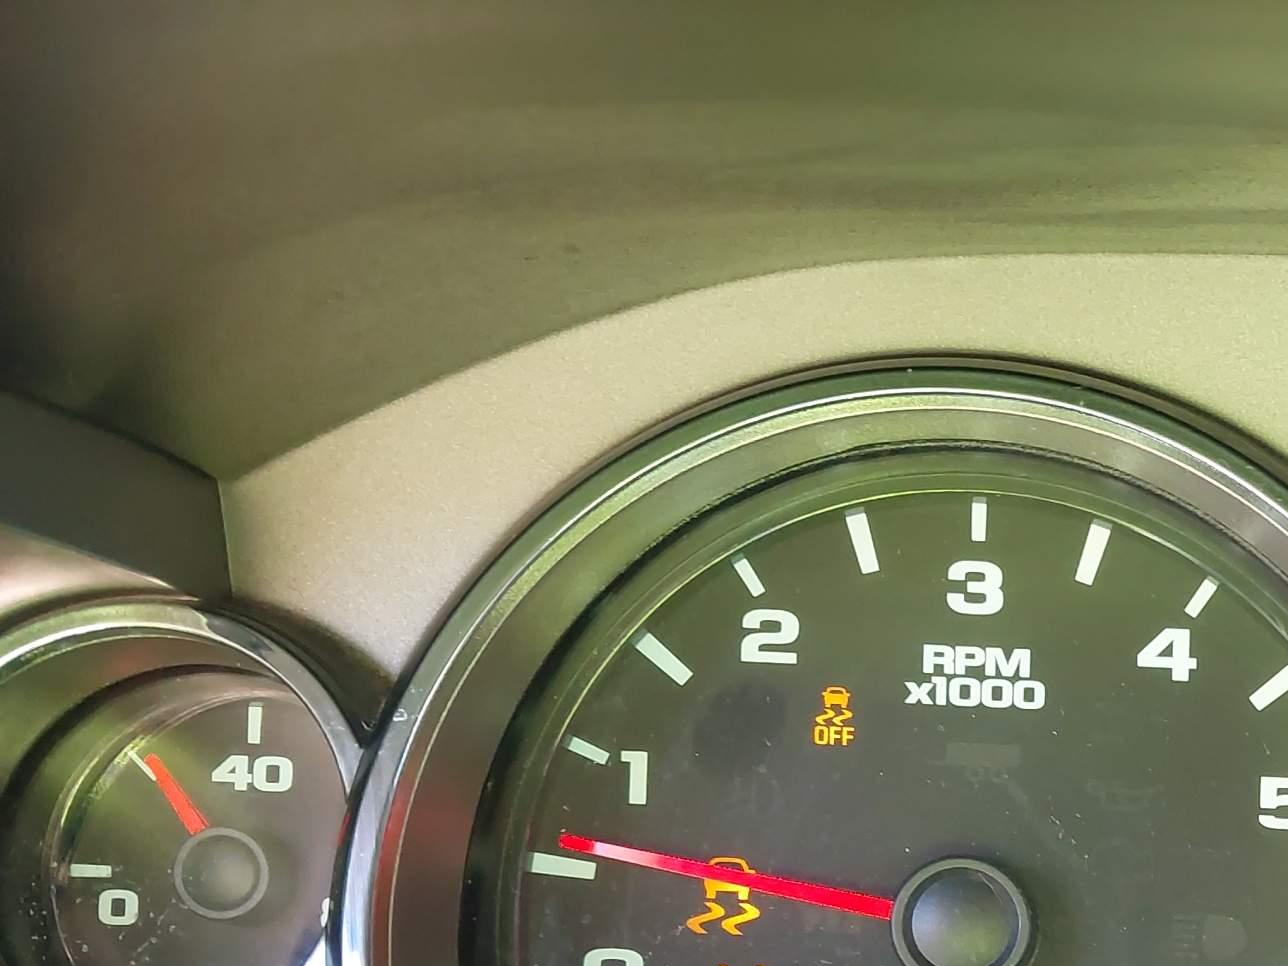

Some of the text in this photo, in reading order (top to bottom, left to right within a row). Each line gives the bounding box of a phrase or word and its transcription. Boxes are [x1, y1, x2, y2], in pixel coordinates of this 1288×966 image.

[946, 560, 1004, 615] 3
[740, 608, 800, 665] 2
[1136, 627, 1198, 682] 4
[922, 643, 1031, 678] RPM
[903, 678, 1046, 710] x1000
[813, 725, 855, 746] OFF
[211, 754, 294, 792] 40
[620, 750, 649, 805] 1
[98, 889, 139, 926] 0
